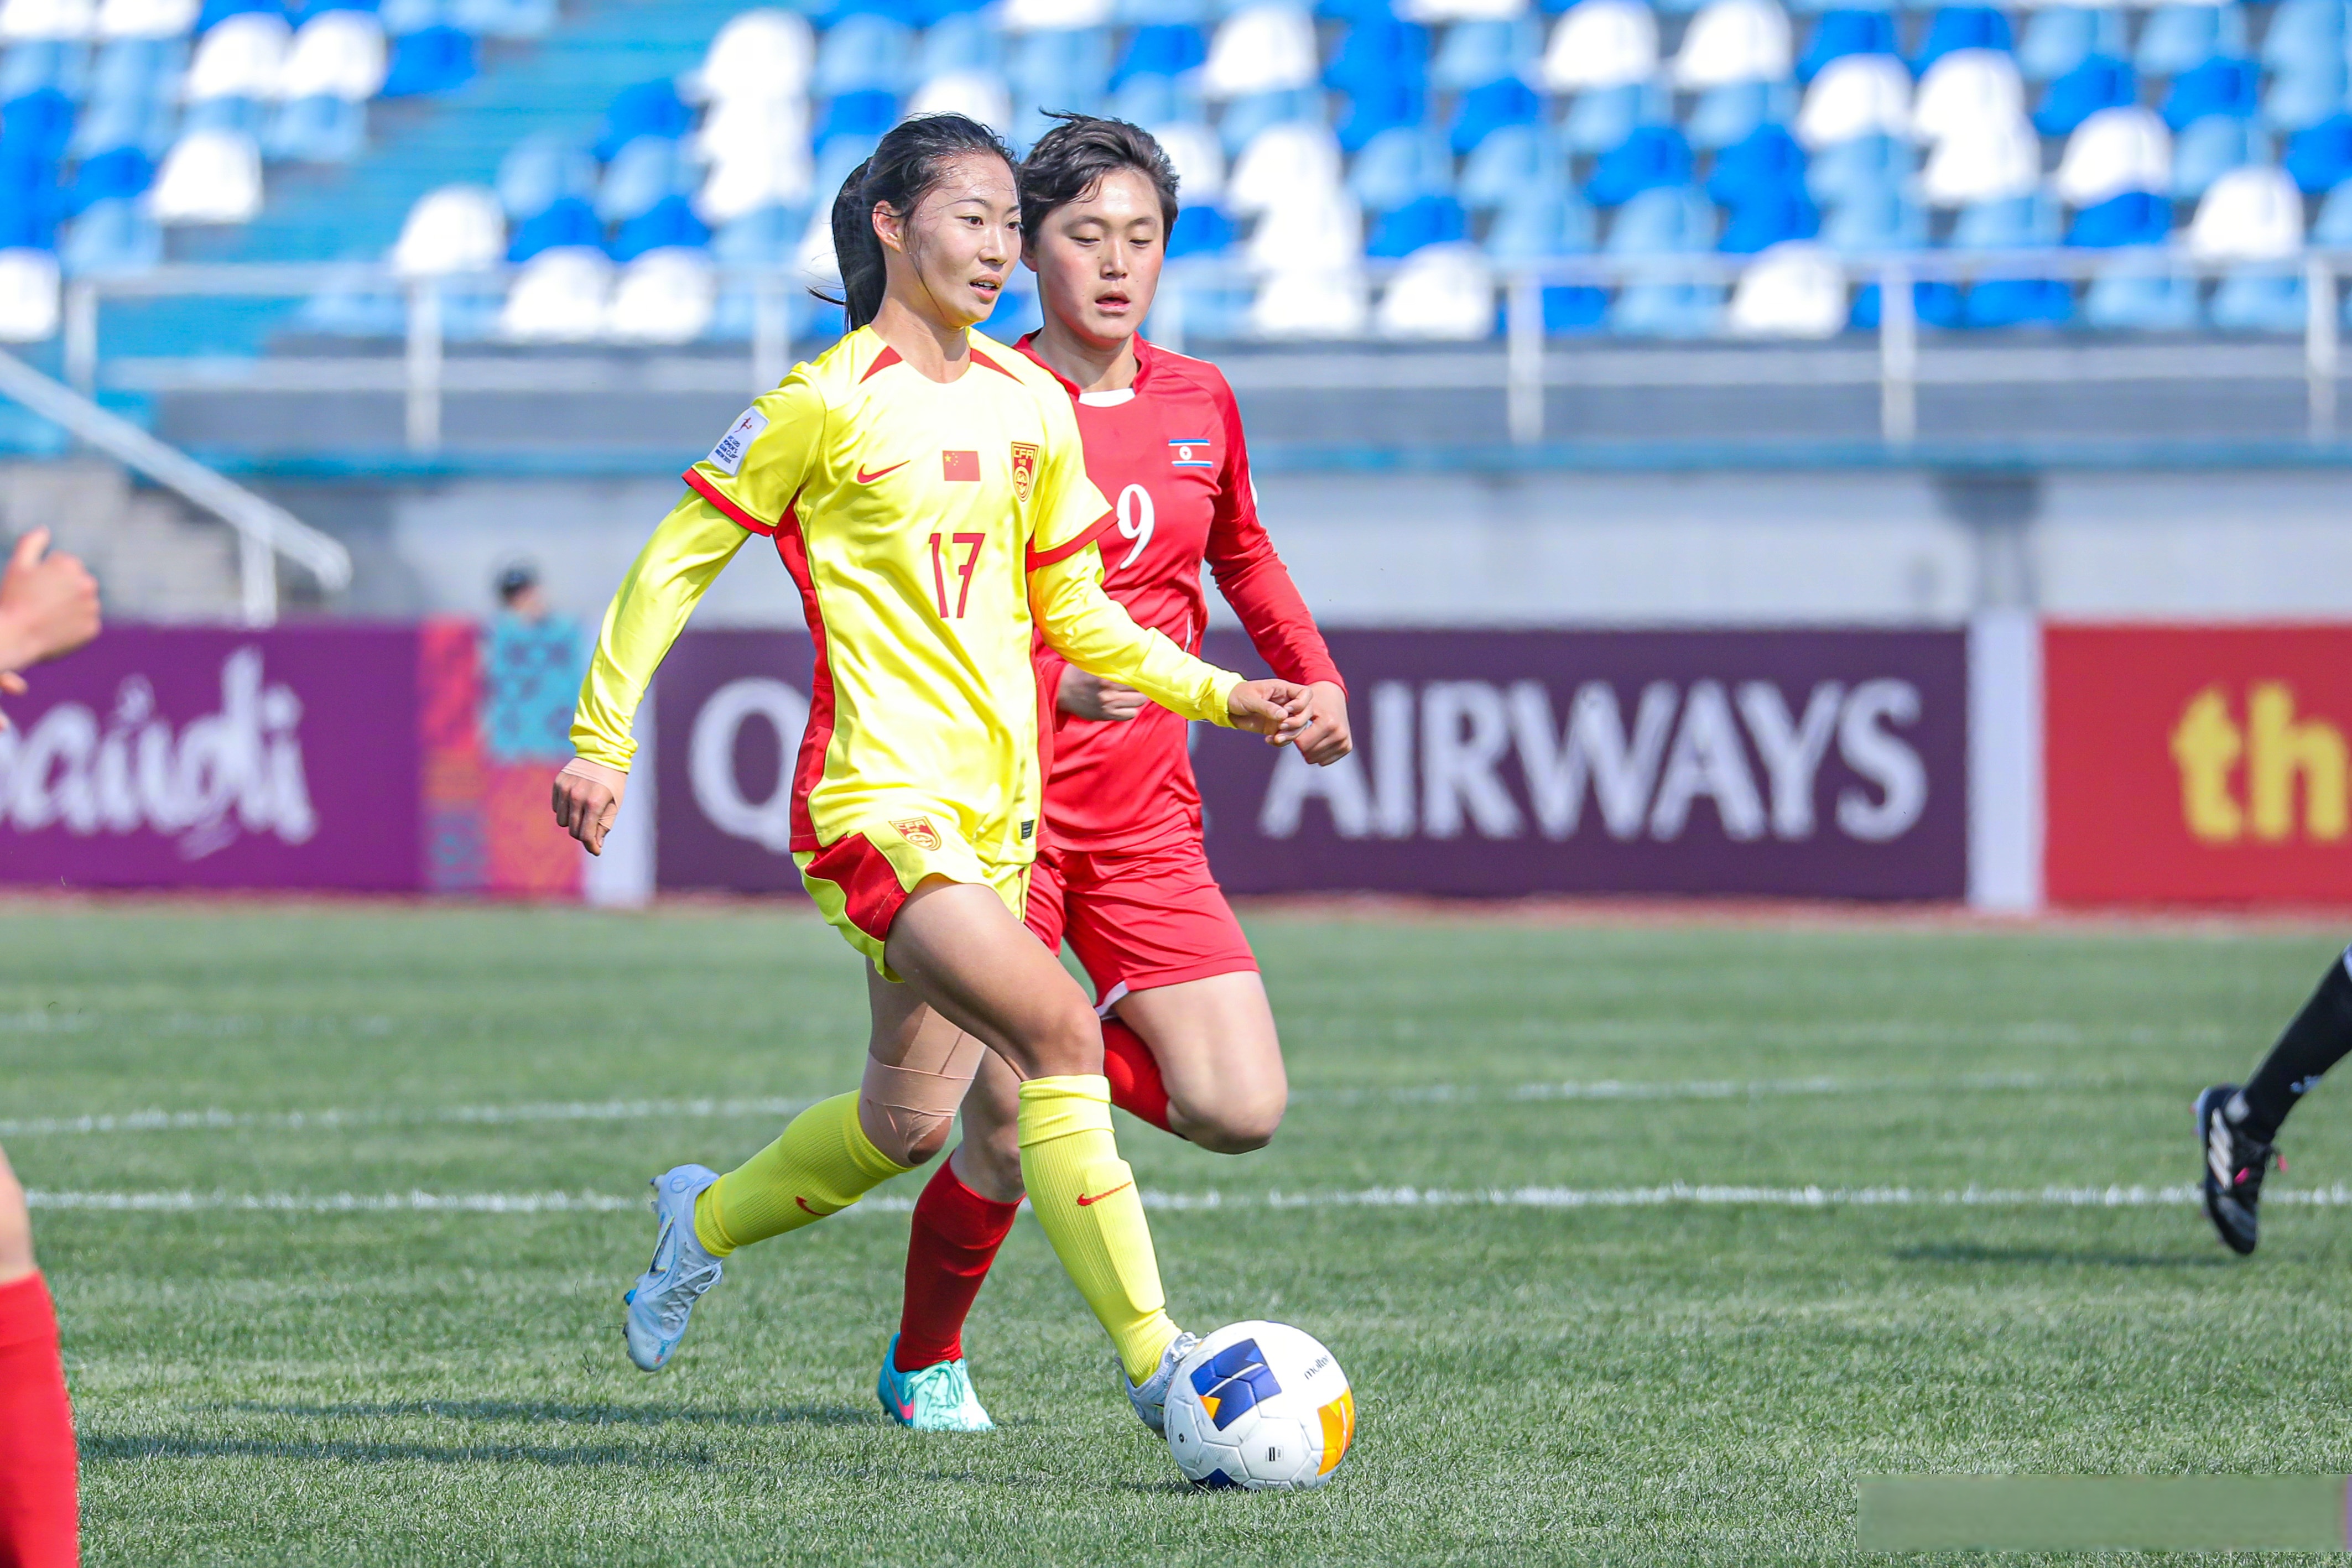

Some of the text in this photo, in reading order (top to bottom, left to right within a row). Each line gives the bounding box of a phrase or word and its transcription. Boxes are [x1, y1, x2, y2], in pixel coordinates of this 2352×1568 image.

[1013, 447, 1034, 460] CFA
[1116, 483, 1155, 569] 9
[929, 533, 986, 618] 17
[0, 643, 316, 846] audi
[1258, 677, 1927, 840] AIRWAYS
[2168, 679, 2352, 846] th
[896, 821, 927, 830] CFA
